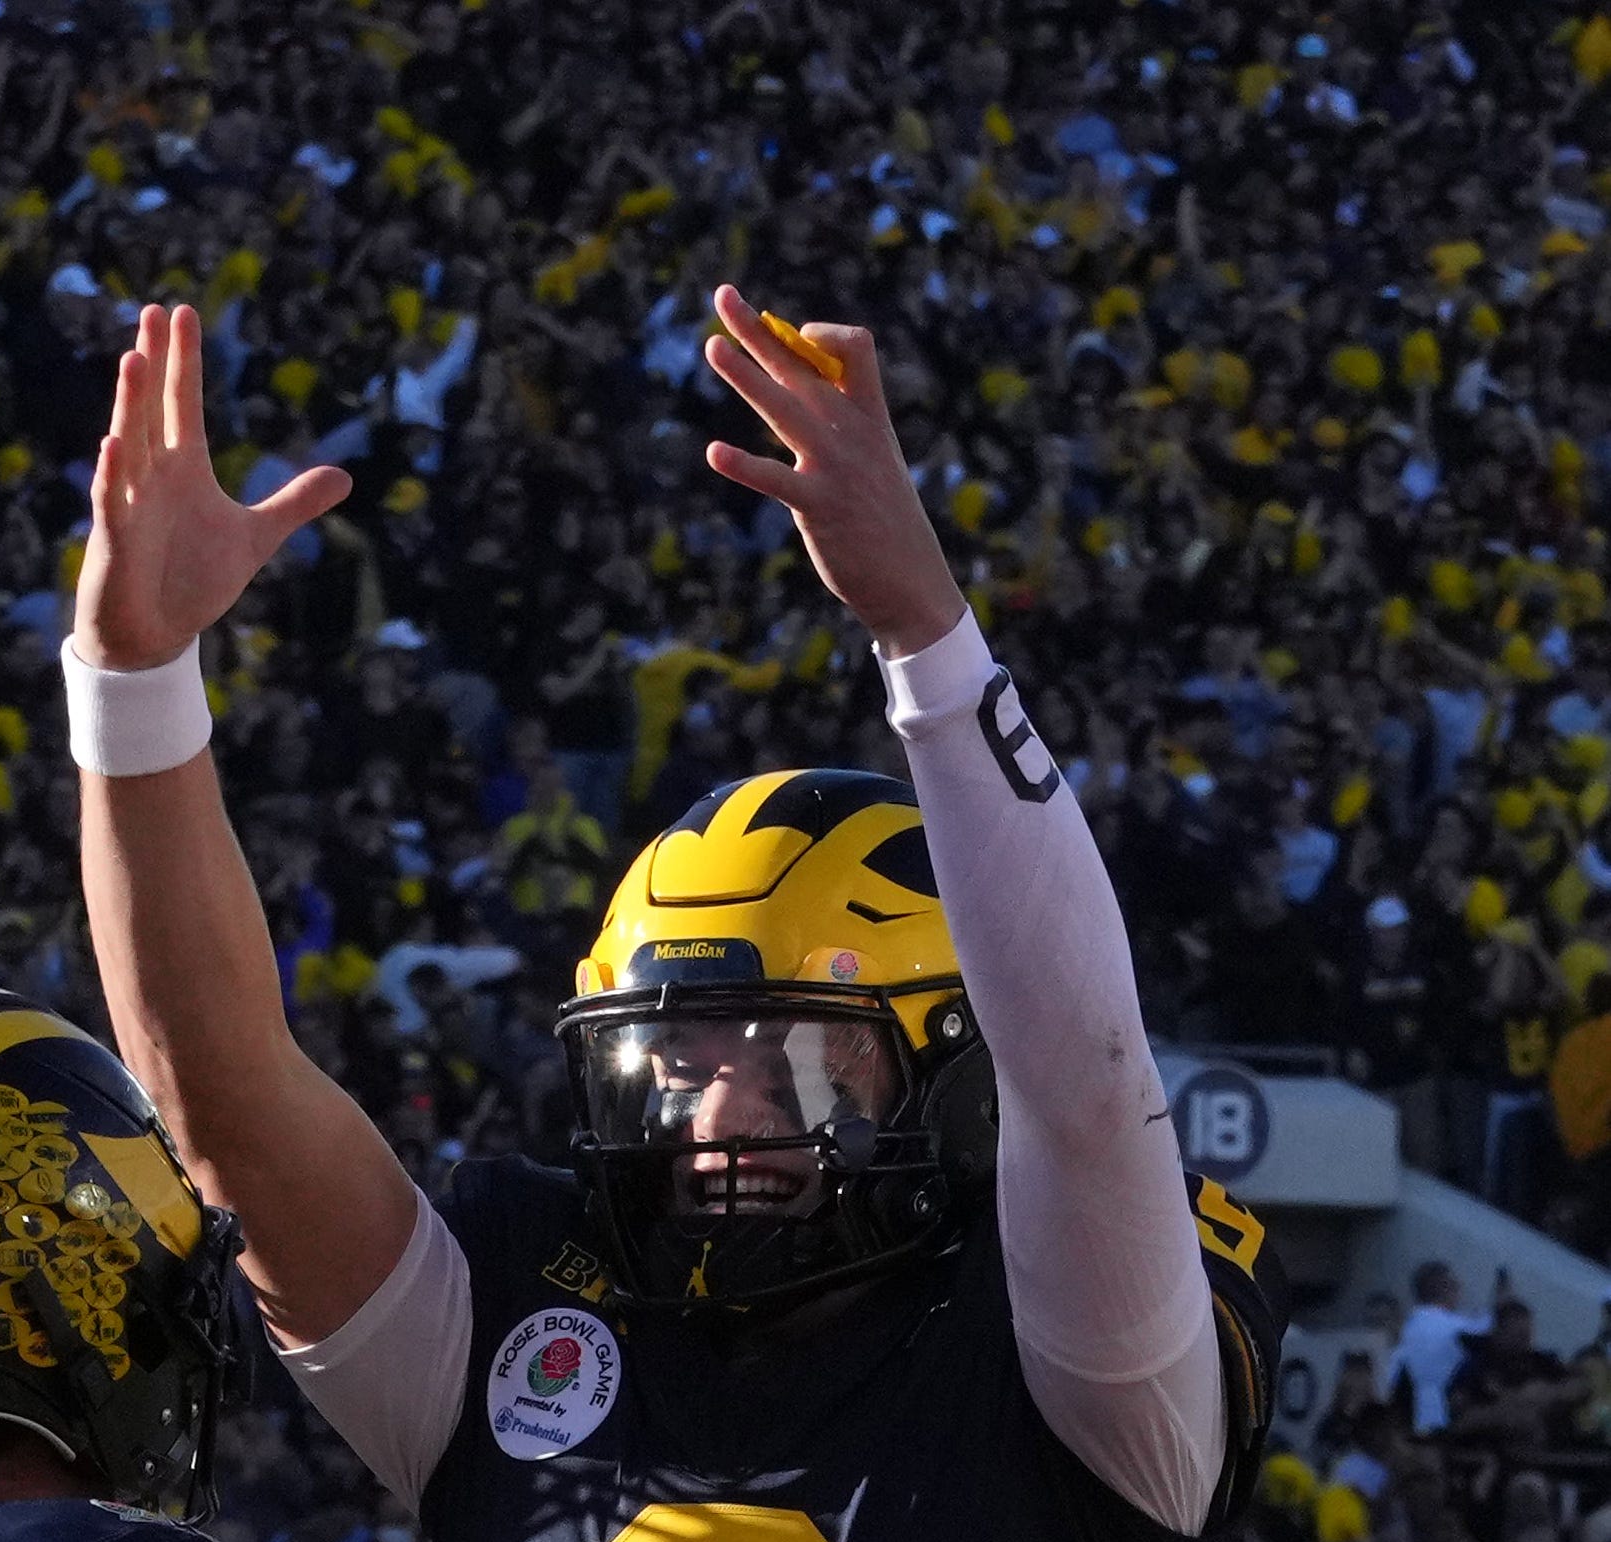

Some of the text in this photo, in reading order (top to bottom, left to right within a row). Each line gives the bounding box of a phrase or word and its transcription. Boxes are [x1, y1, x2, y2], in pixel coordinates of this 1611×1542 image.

[497, 1316, 614, 1409] ROSE BOWL GAME
[511, 1418, 570, 1446] Prudential
